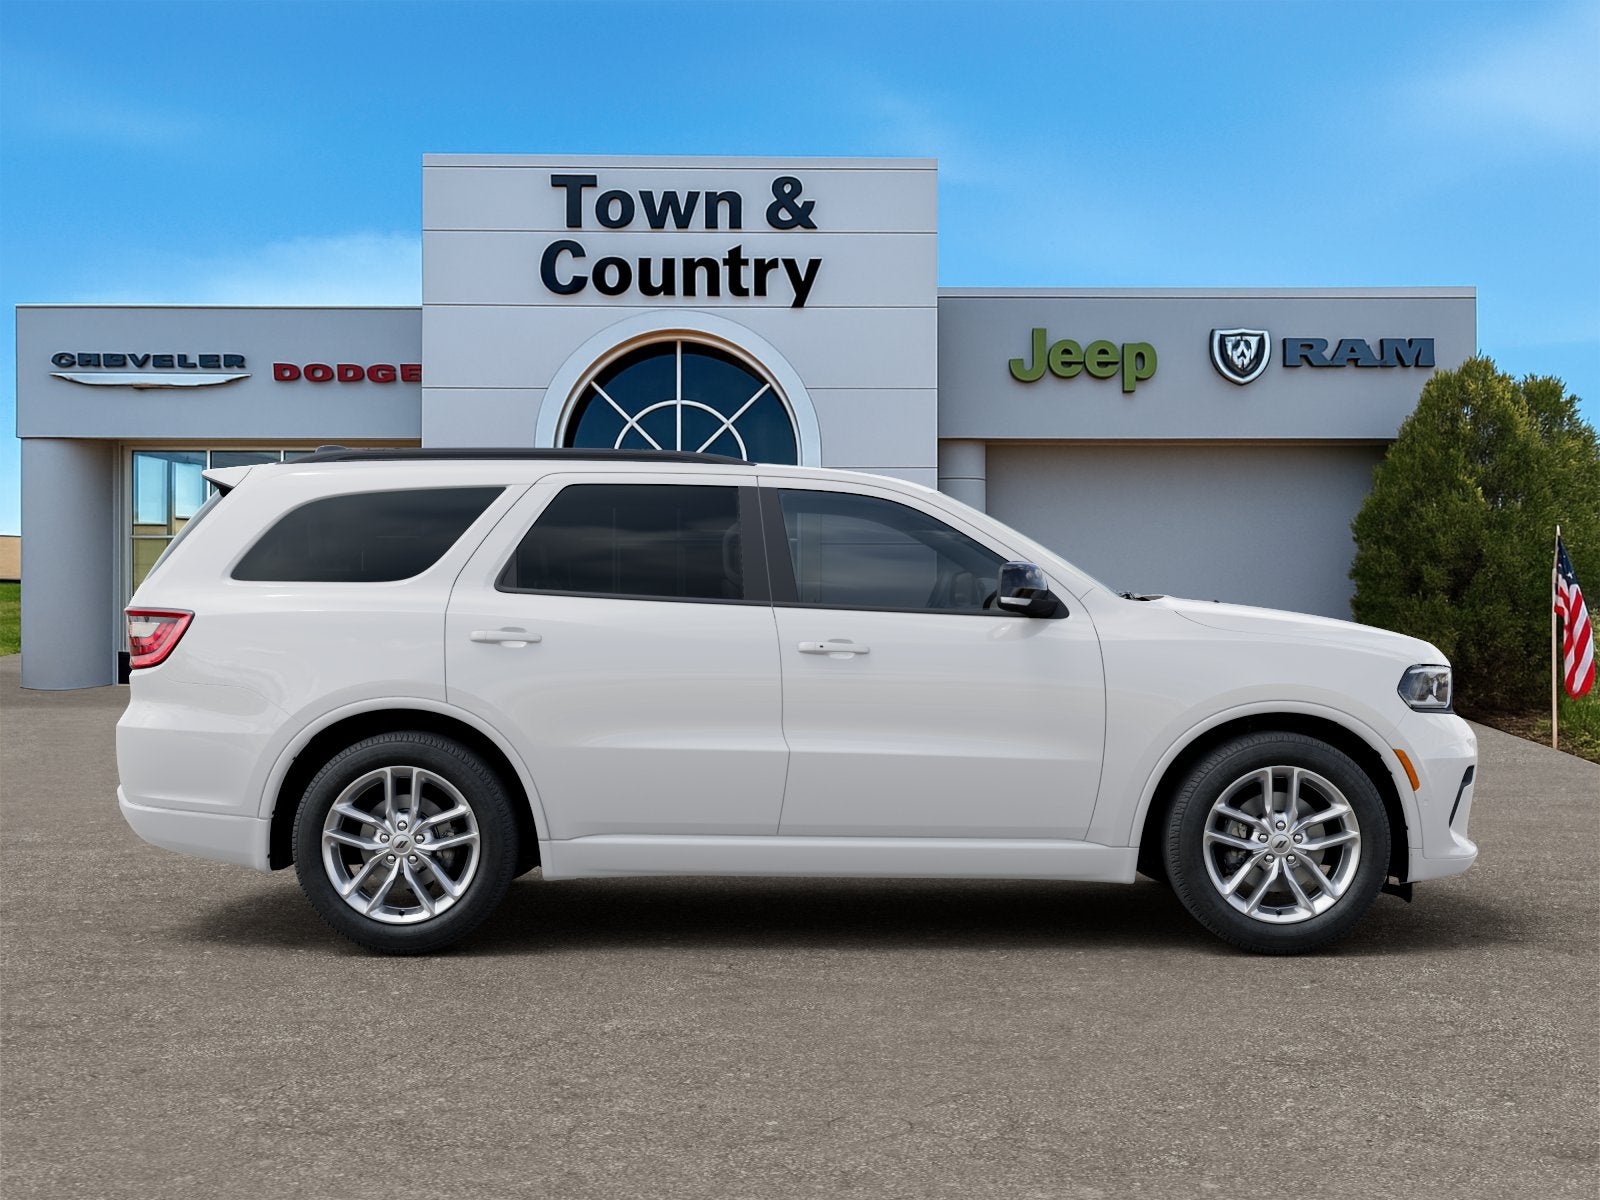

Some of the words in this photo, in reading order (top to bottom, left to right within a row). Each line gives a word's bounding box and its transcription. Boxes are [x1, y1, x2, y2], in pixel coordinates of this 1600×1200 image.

[550, 174, 742, 229] Town
[765, 175, 818, 230] &
[540, 239, 822, 308] Country
[272, 362, 422, 384] DODGE
[1009, 328, 1157, 393] Jeep
[1283, 337, 1436, 368] RAM
